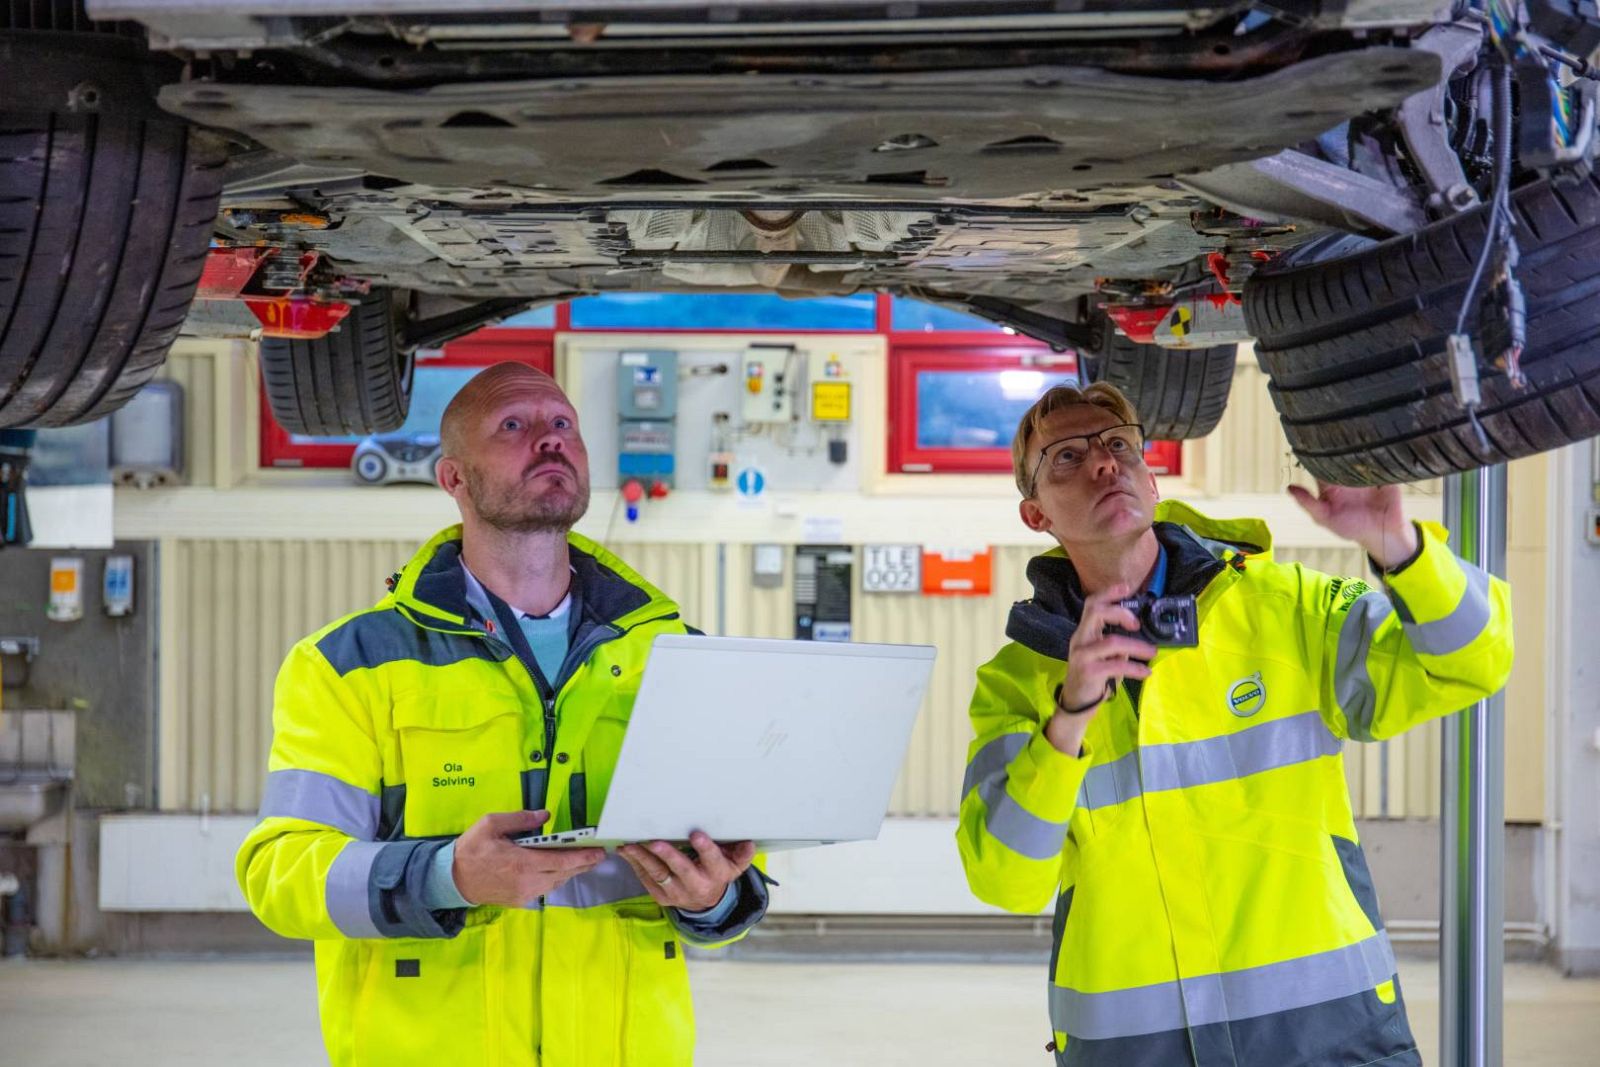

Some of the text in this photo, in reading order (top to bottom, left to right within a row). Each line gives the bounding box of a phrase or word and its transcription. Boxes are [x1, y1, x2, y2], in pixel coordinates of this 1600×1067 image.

[870, 546, 913, 569] TLE
[866, 569, 913, 588] 002
[1232, 689, 1261, 704] VOLVO
[443, 763, 463, 773] Ola
[432, 776, 475, 787] Solving
